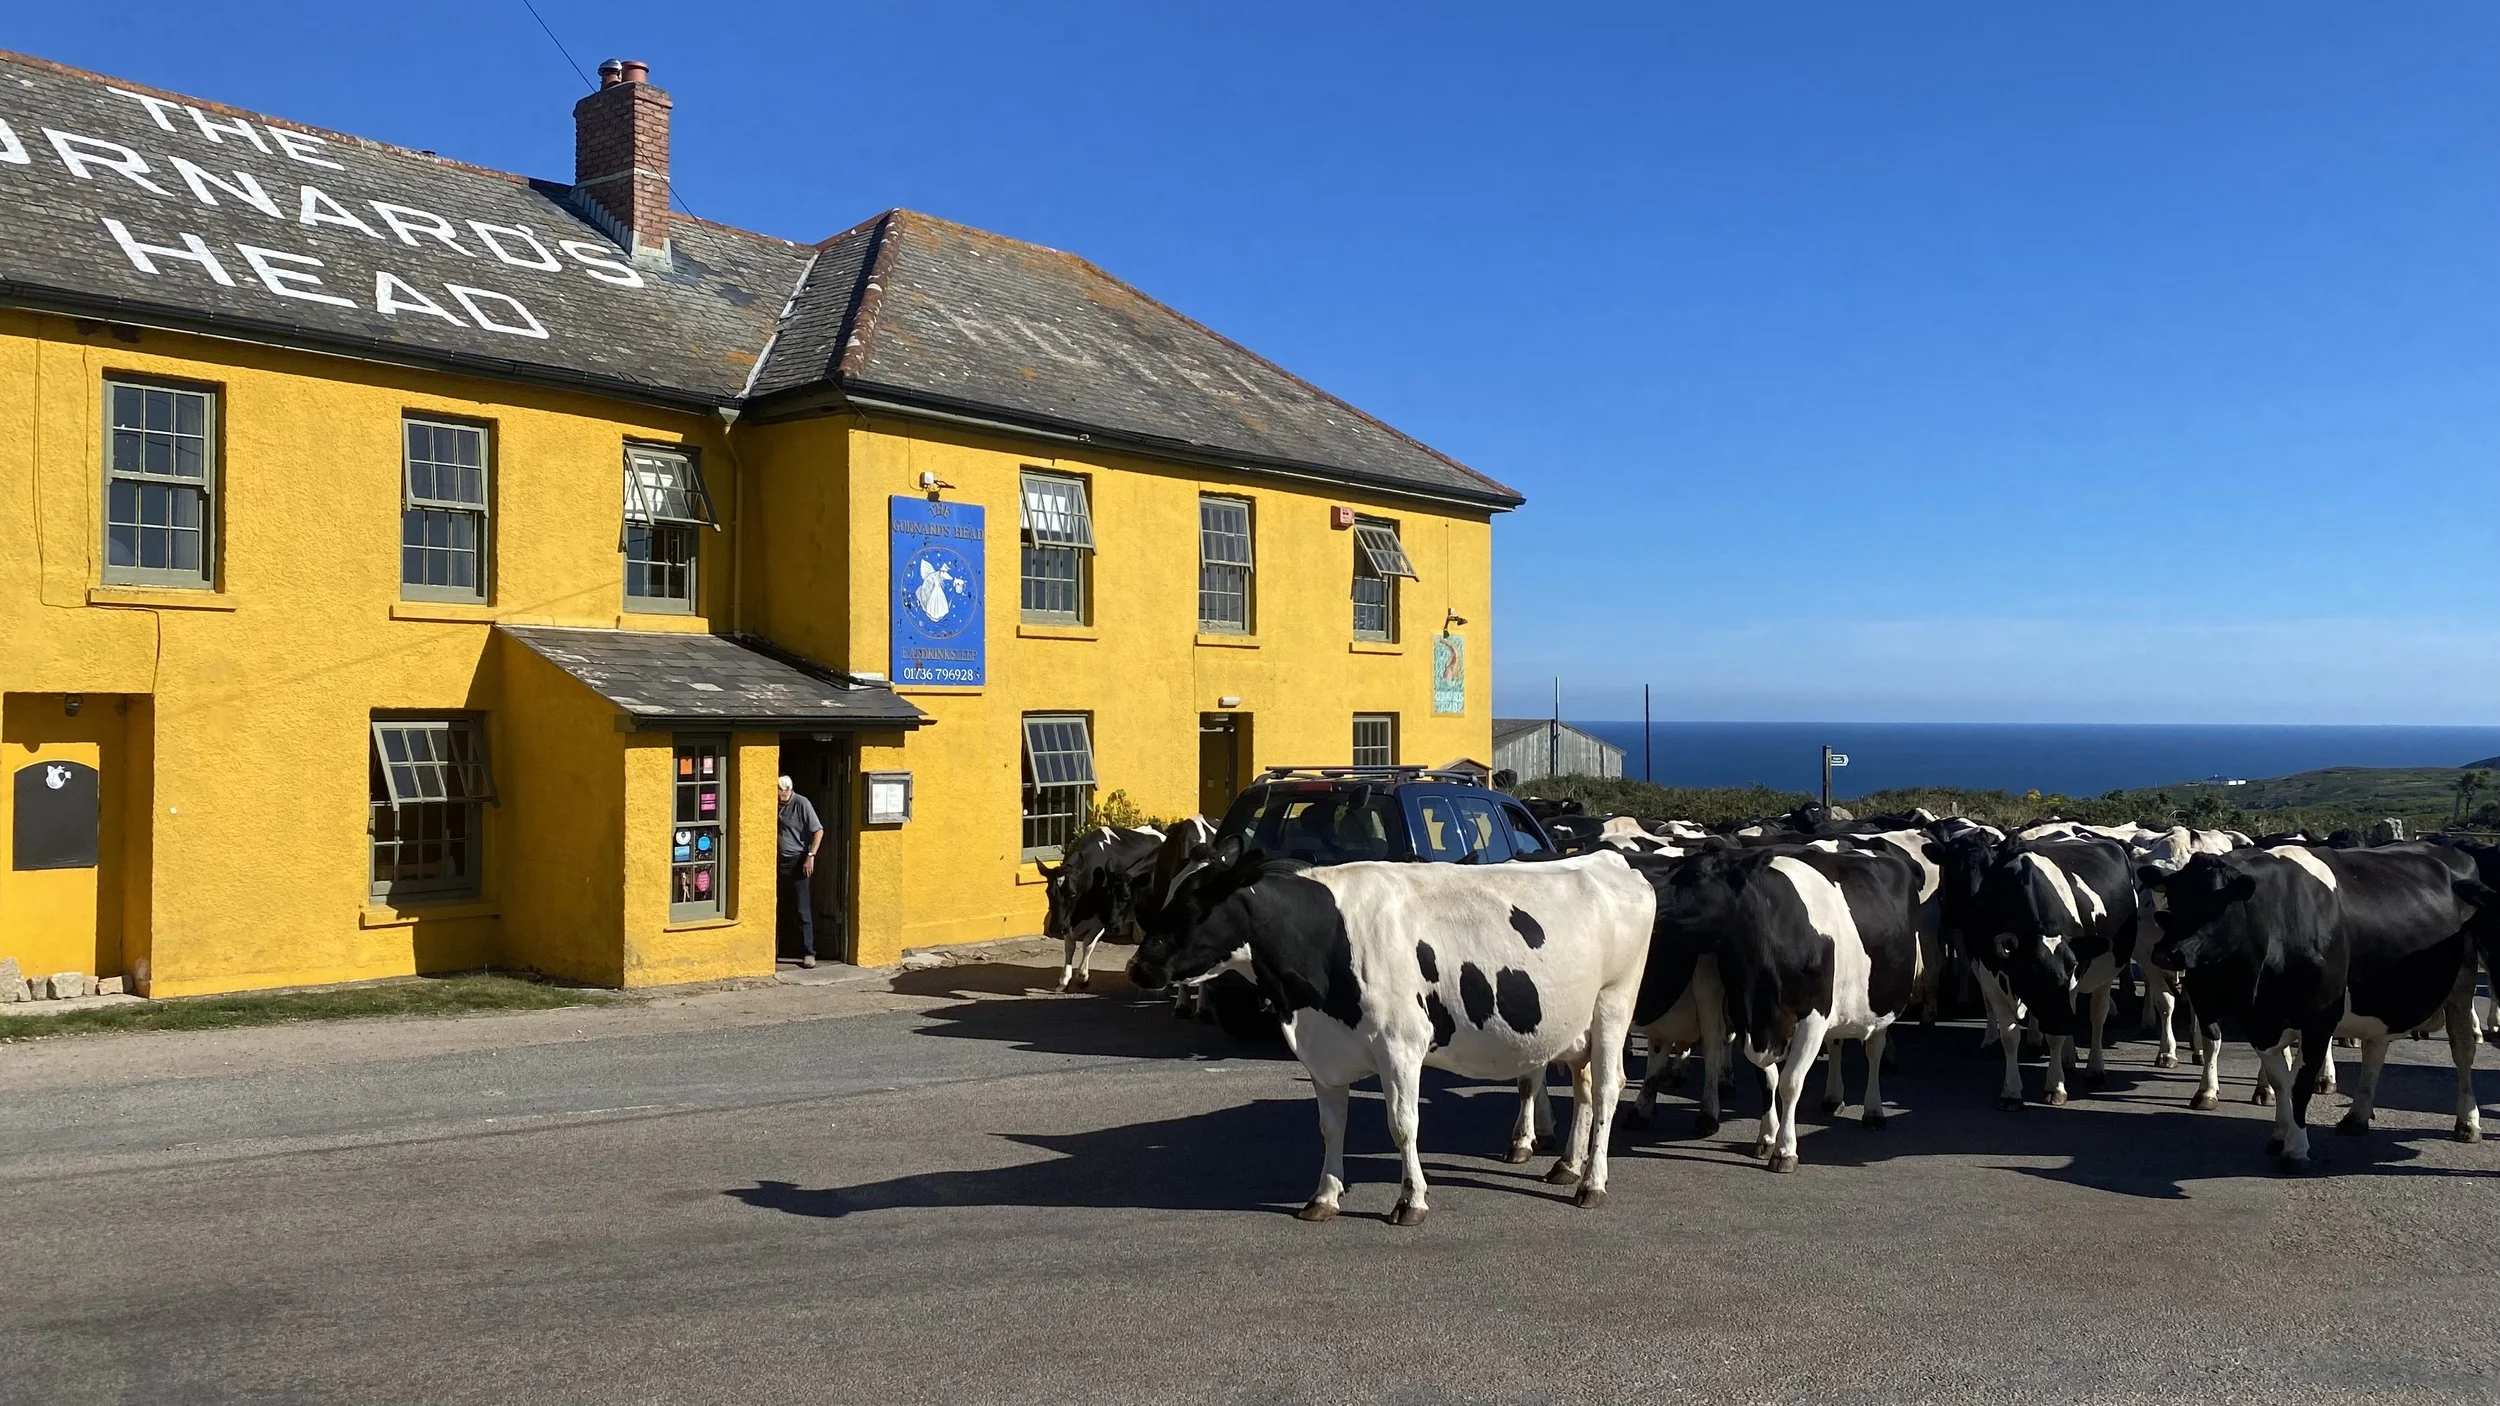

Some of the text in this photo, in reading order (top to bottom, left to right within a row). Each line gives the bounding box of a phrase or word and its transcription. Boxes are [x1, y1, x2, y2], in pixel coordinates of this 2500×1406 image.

[105, 86, 345, 171] THE
[102, 217, 550, 339] HEAD
[928, 503, 952, 519] THE
[955, 525, 984, 541] HEAD
[903, 667, 974, 682] 01736 796928
